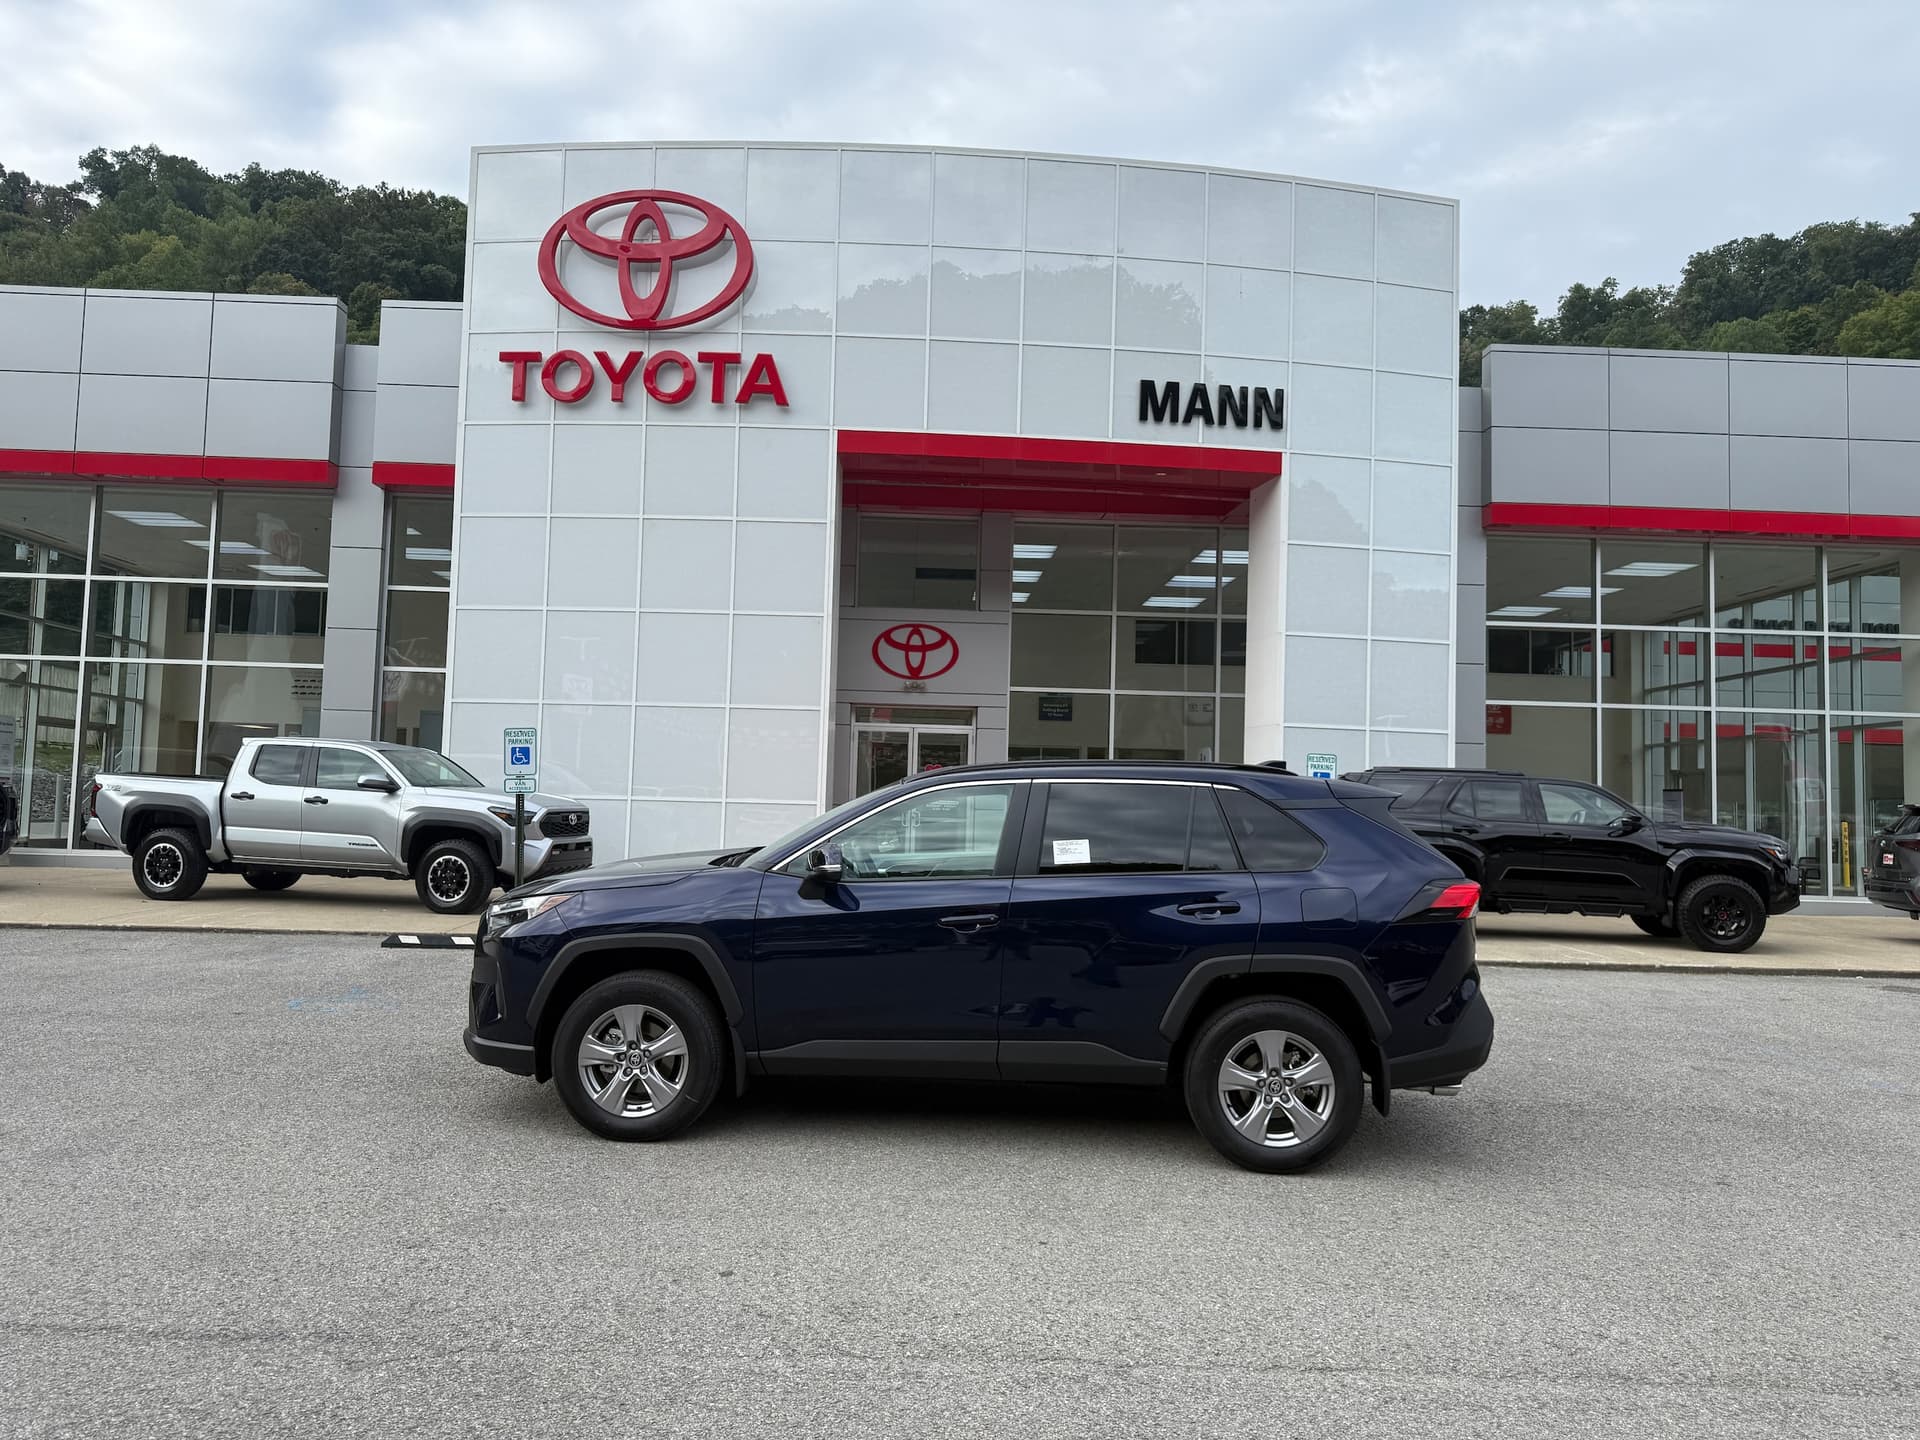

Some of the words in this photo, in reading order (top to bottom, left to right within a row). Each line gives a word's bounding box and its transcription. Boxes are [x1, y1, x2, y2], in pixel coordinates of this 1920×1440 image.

[499, 350, 789, 407] TOYOTA
[1139, 379, 1284, 429] MANN
[1310, 763, 1333, 771] PARKING
